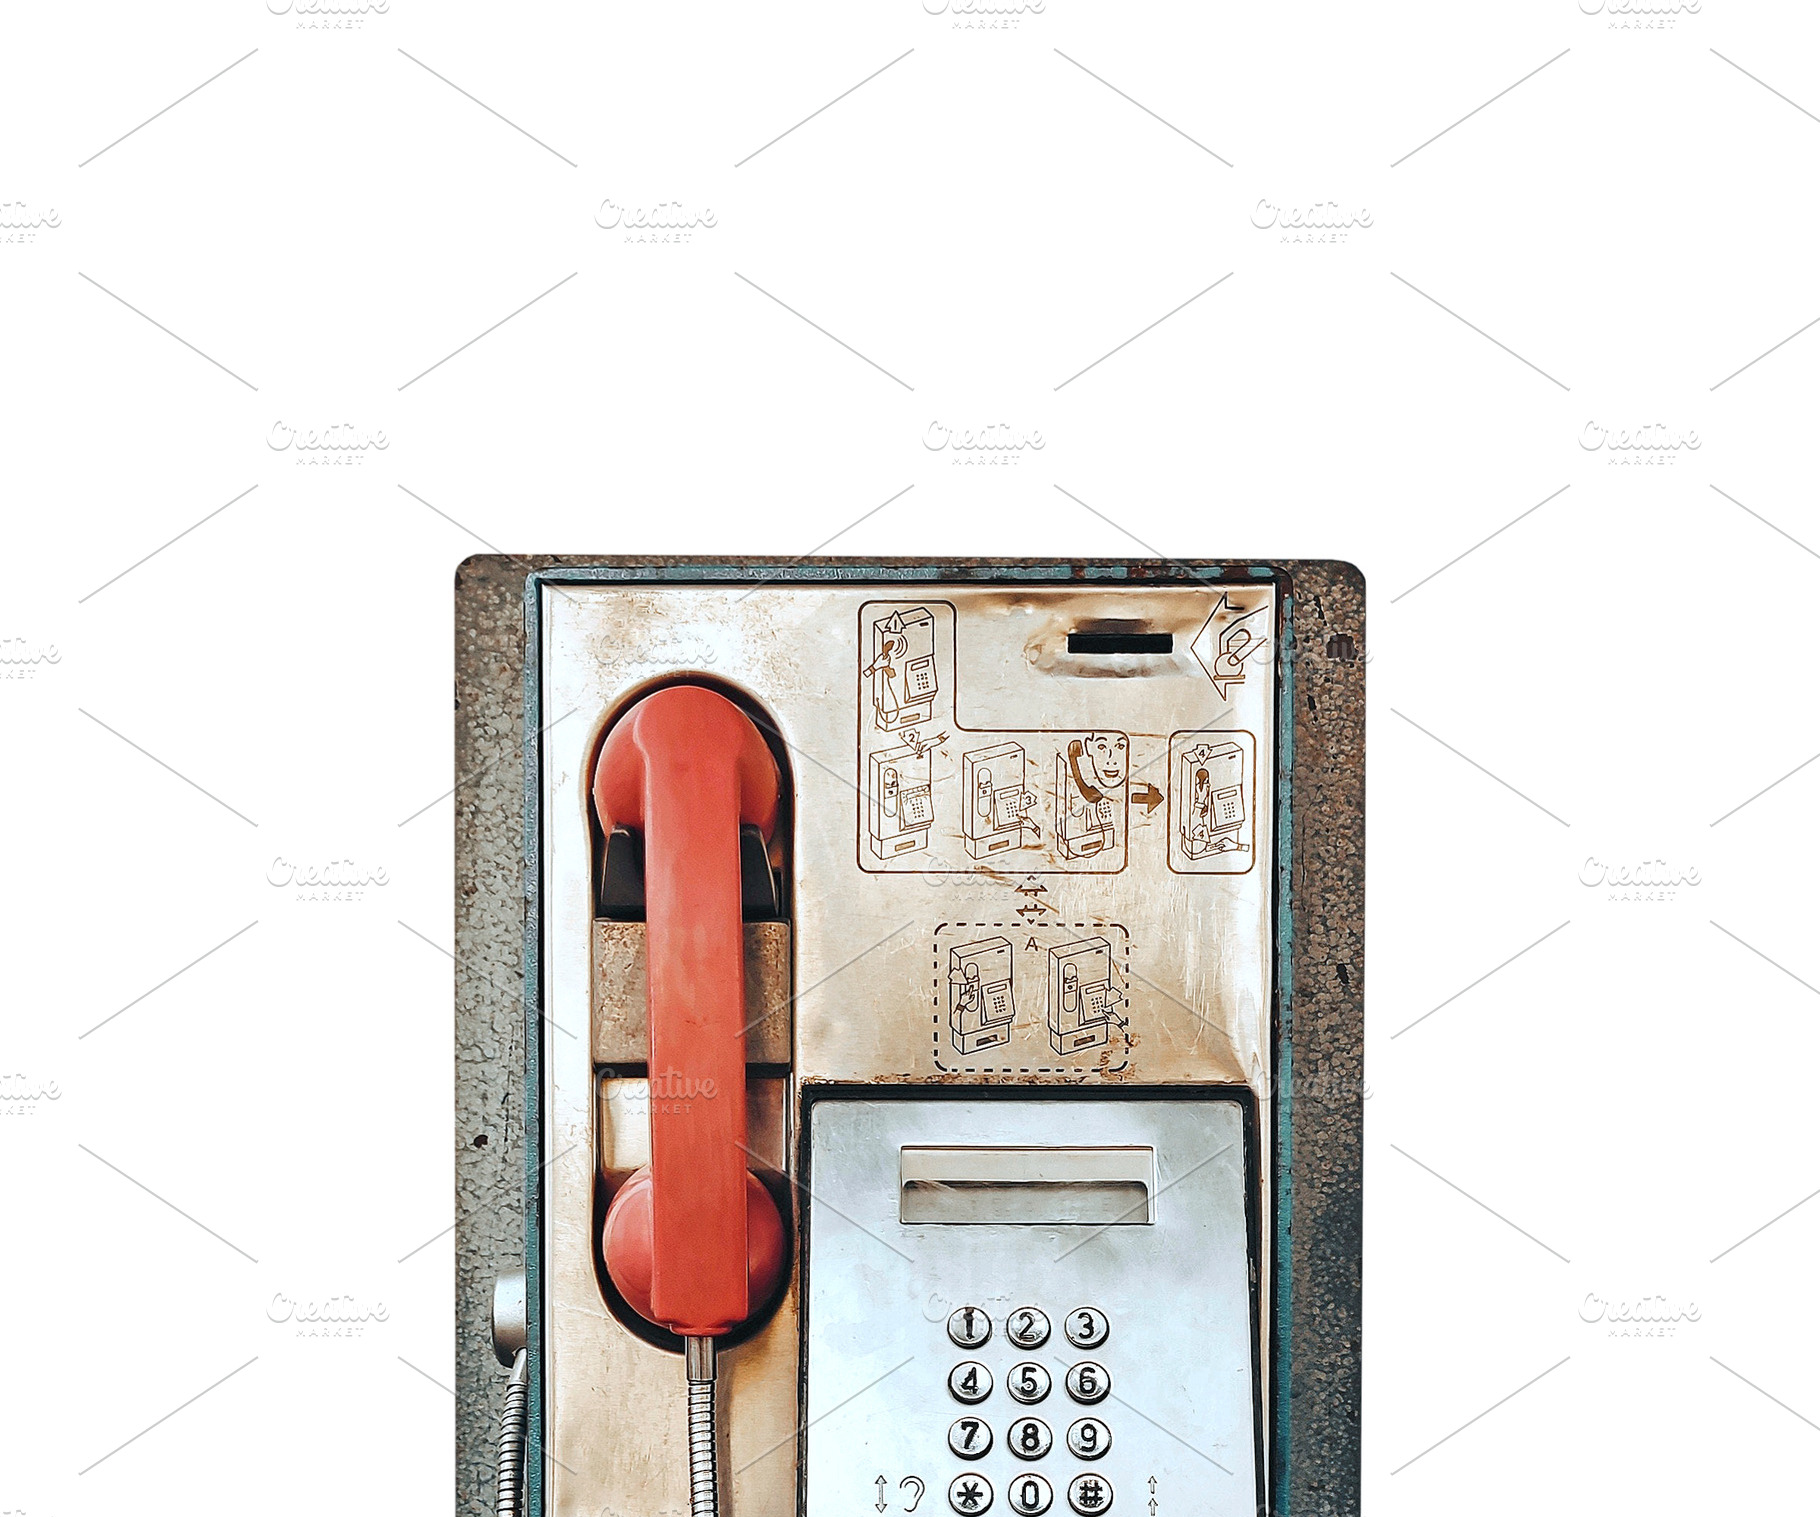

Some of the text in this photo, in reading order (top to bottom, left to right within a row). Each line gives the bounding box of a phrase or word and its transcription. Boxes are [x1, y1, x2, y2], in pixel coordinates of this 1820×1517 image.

[907, 733, 916, 743] 2
[1024, 936, 1039, 952] A
[1018, 1311, 1035, 1341] 2
[1077, 1312, 1095, 1340] 3
[961, 1366, 1098, 1395] 4 5 6
[961, 1420, 1098, 1452] 7 8 9
[1021, 1480, 1040, 1509] 0
